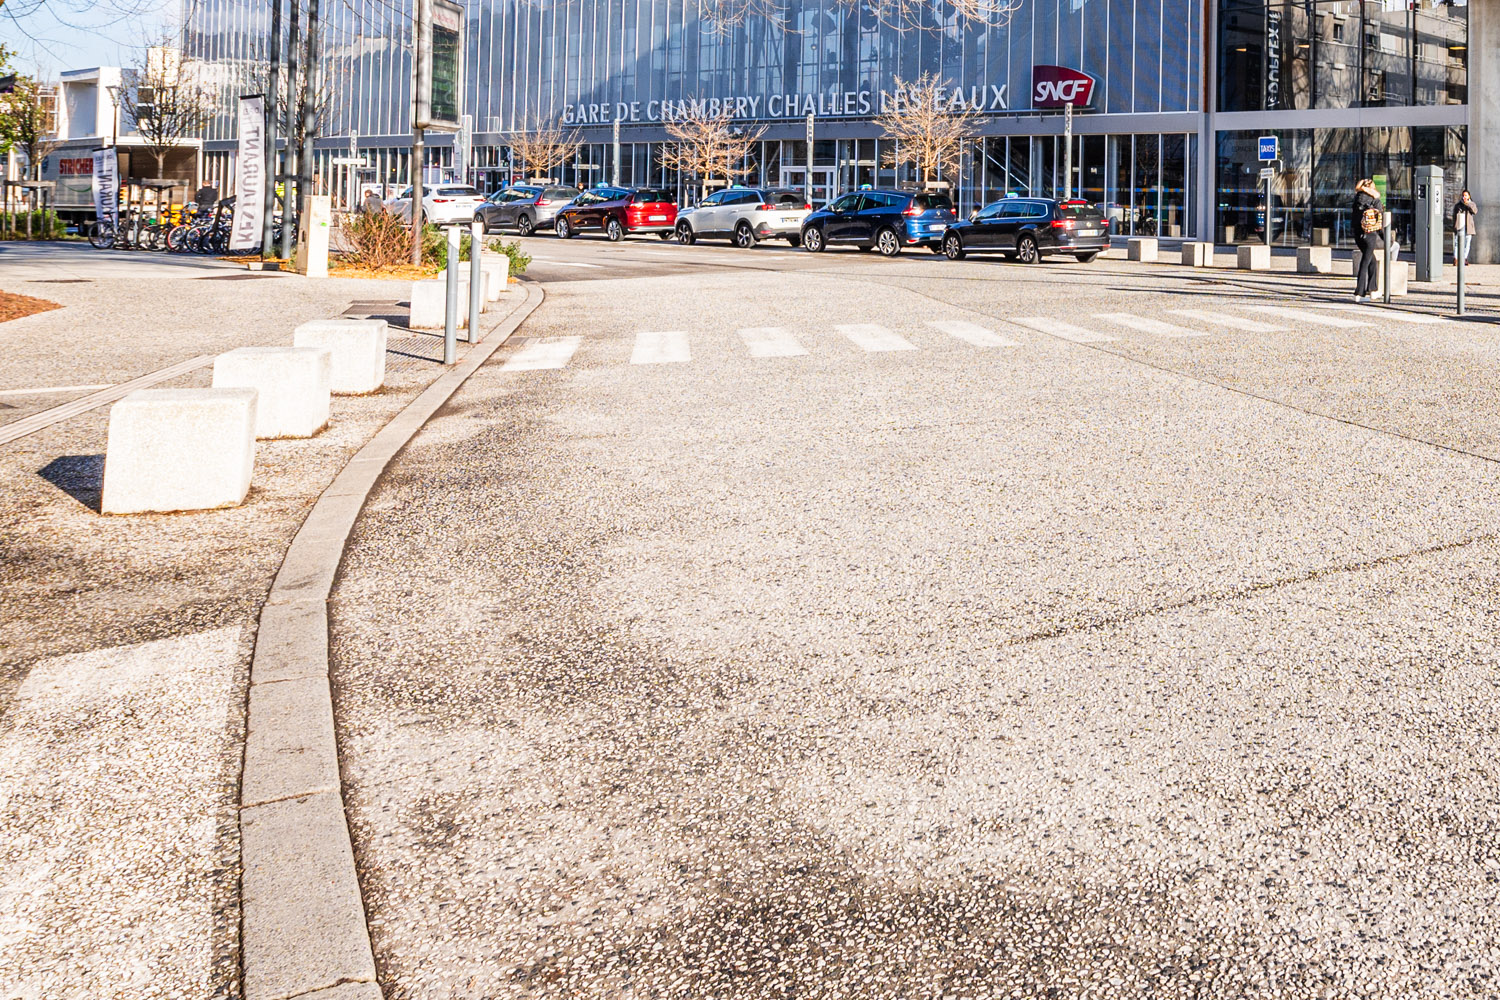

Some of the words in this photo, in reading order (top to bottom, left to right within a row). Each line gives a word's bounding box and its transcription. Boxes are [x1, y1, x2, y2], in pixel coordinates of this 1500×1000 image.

[1034, 79, 1088, 102] SNCF
[563, 103, 610, 124] GARE
[617, 101, 641, 122] DE
[646, 95, 761, 121] CHAMBERY
[768, 90, 871, 118] CHALLES
[934, 83, 1008, 112] EAUX
[1260, 144, 1275, 153] TAXIS
